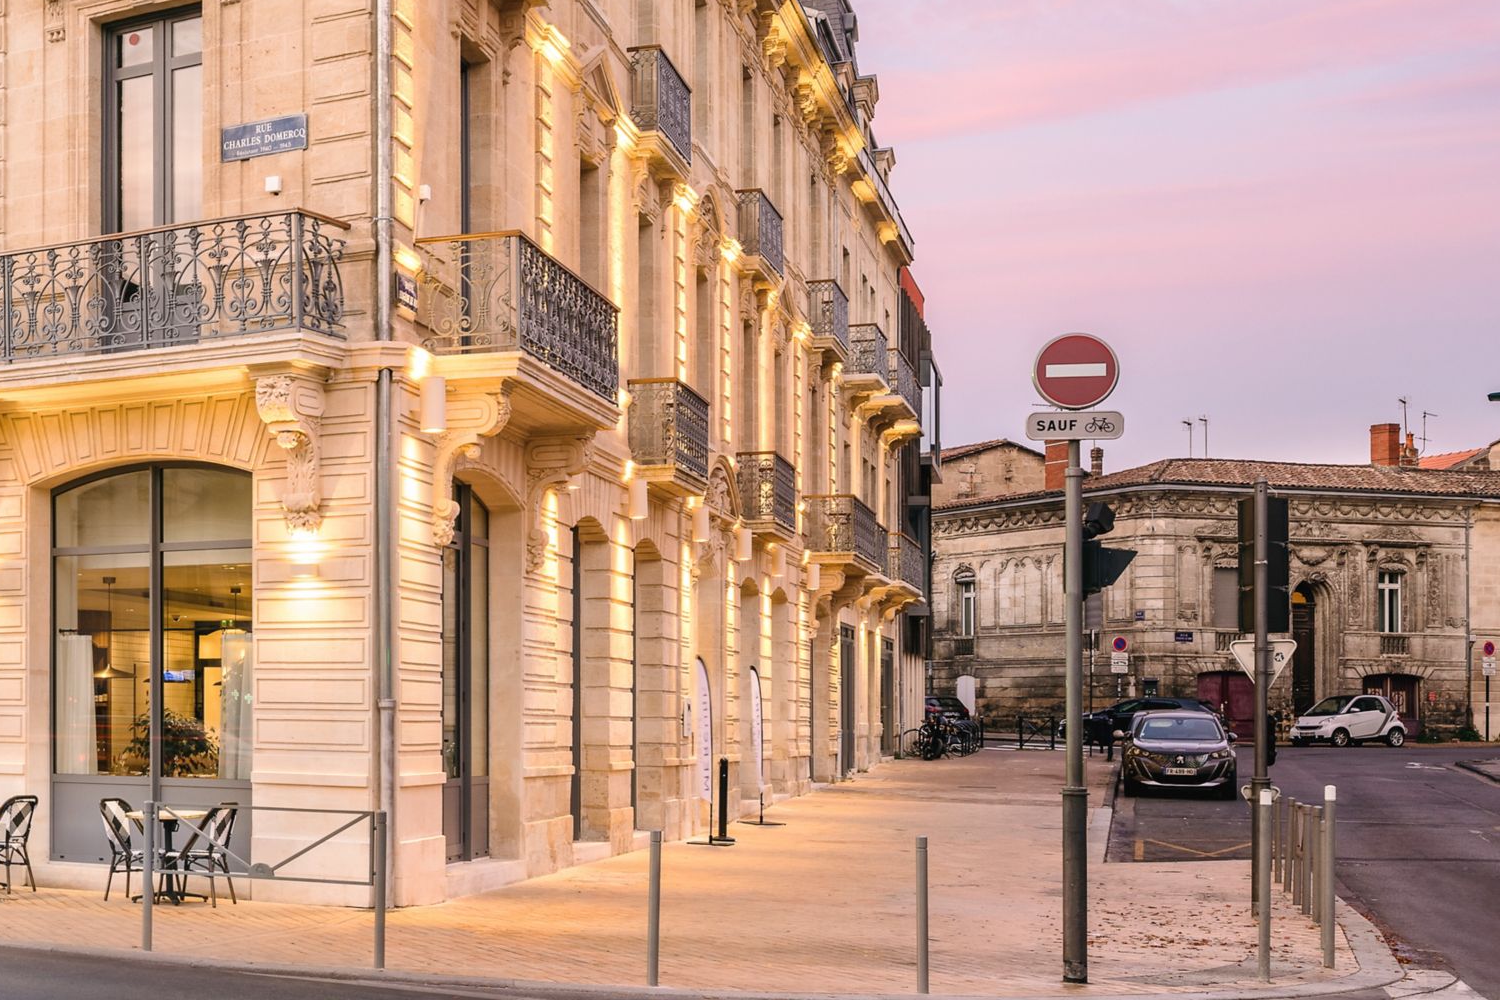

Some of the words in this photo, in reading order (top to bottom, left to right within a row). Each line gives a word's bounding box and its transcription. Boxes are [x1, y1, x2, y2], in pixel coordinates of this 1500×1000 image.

[255, 123, 273, 134] RUE
[223, 136, 261, 150] CHARLES
[264, 128, 306, 143] DOMERCQ
[1036, 419, 1078, 432] SAUF
